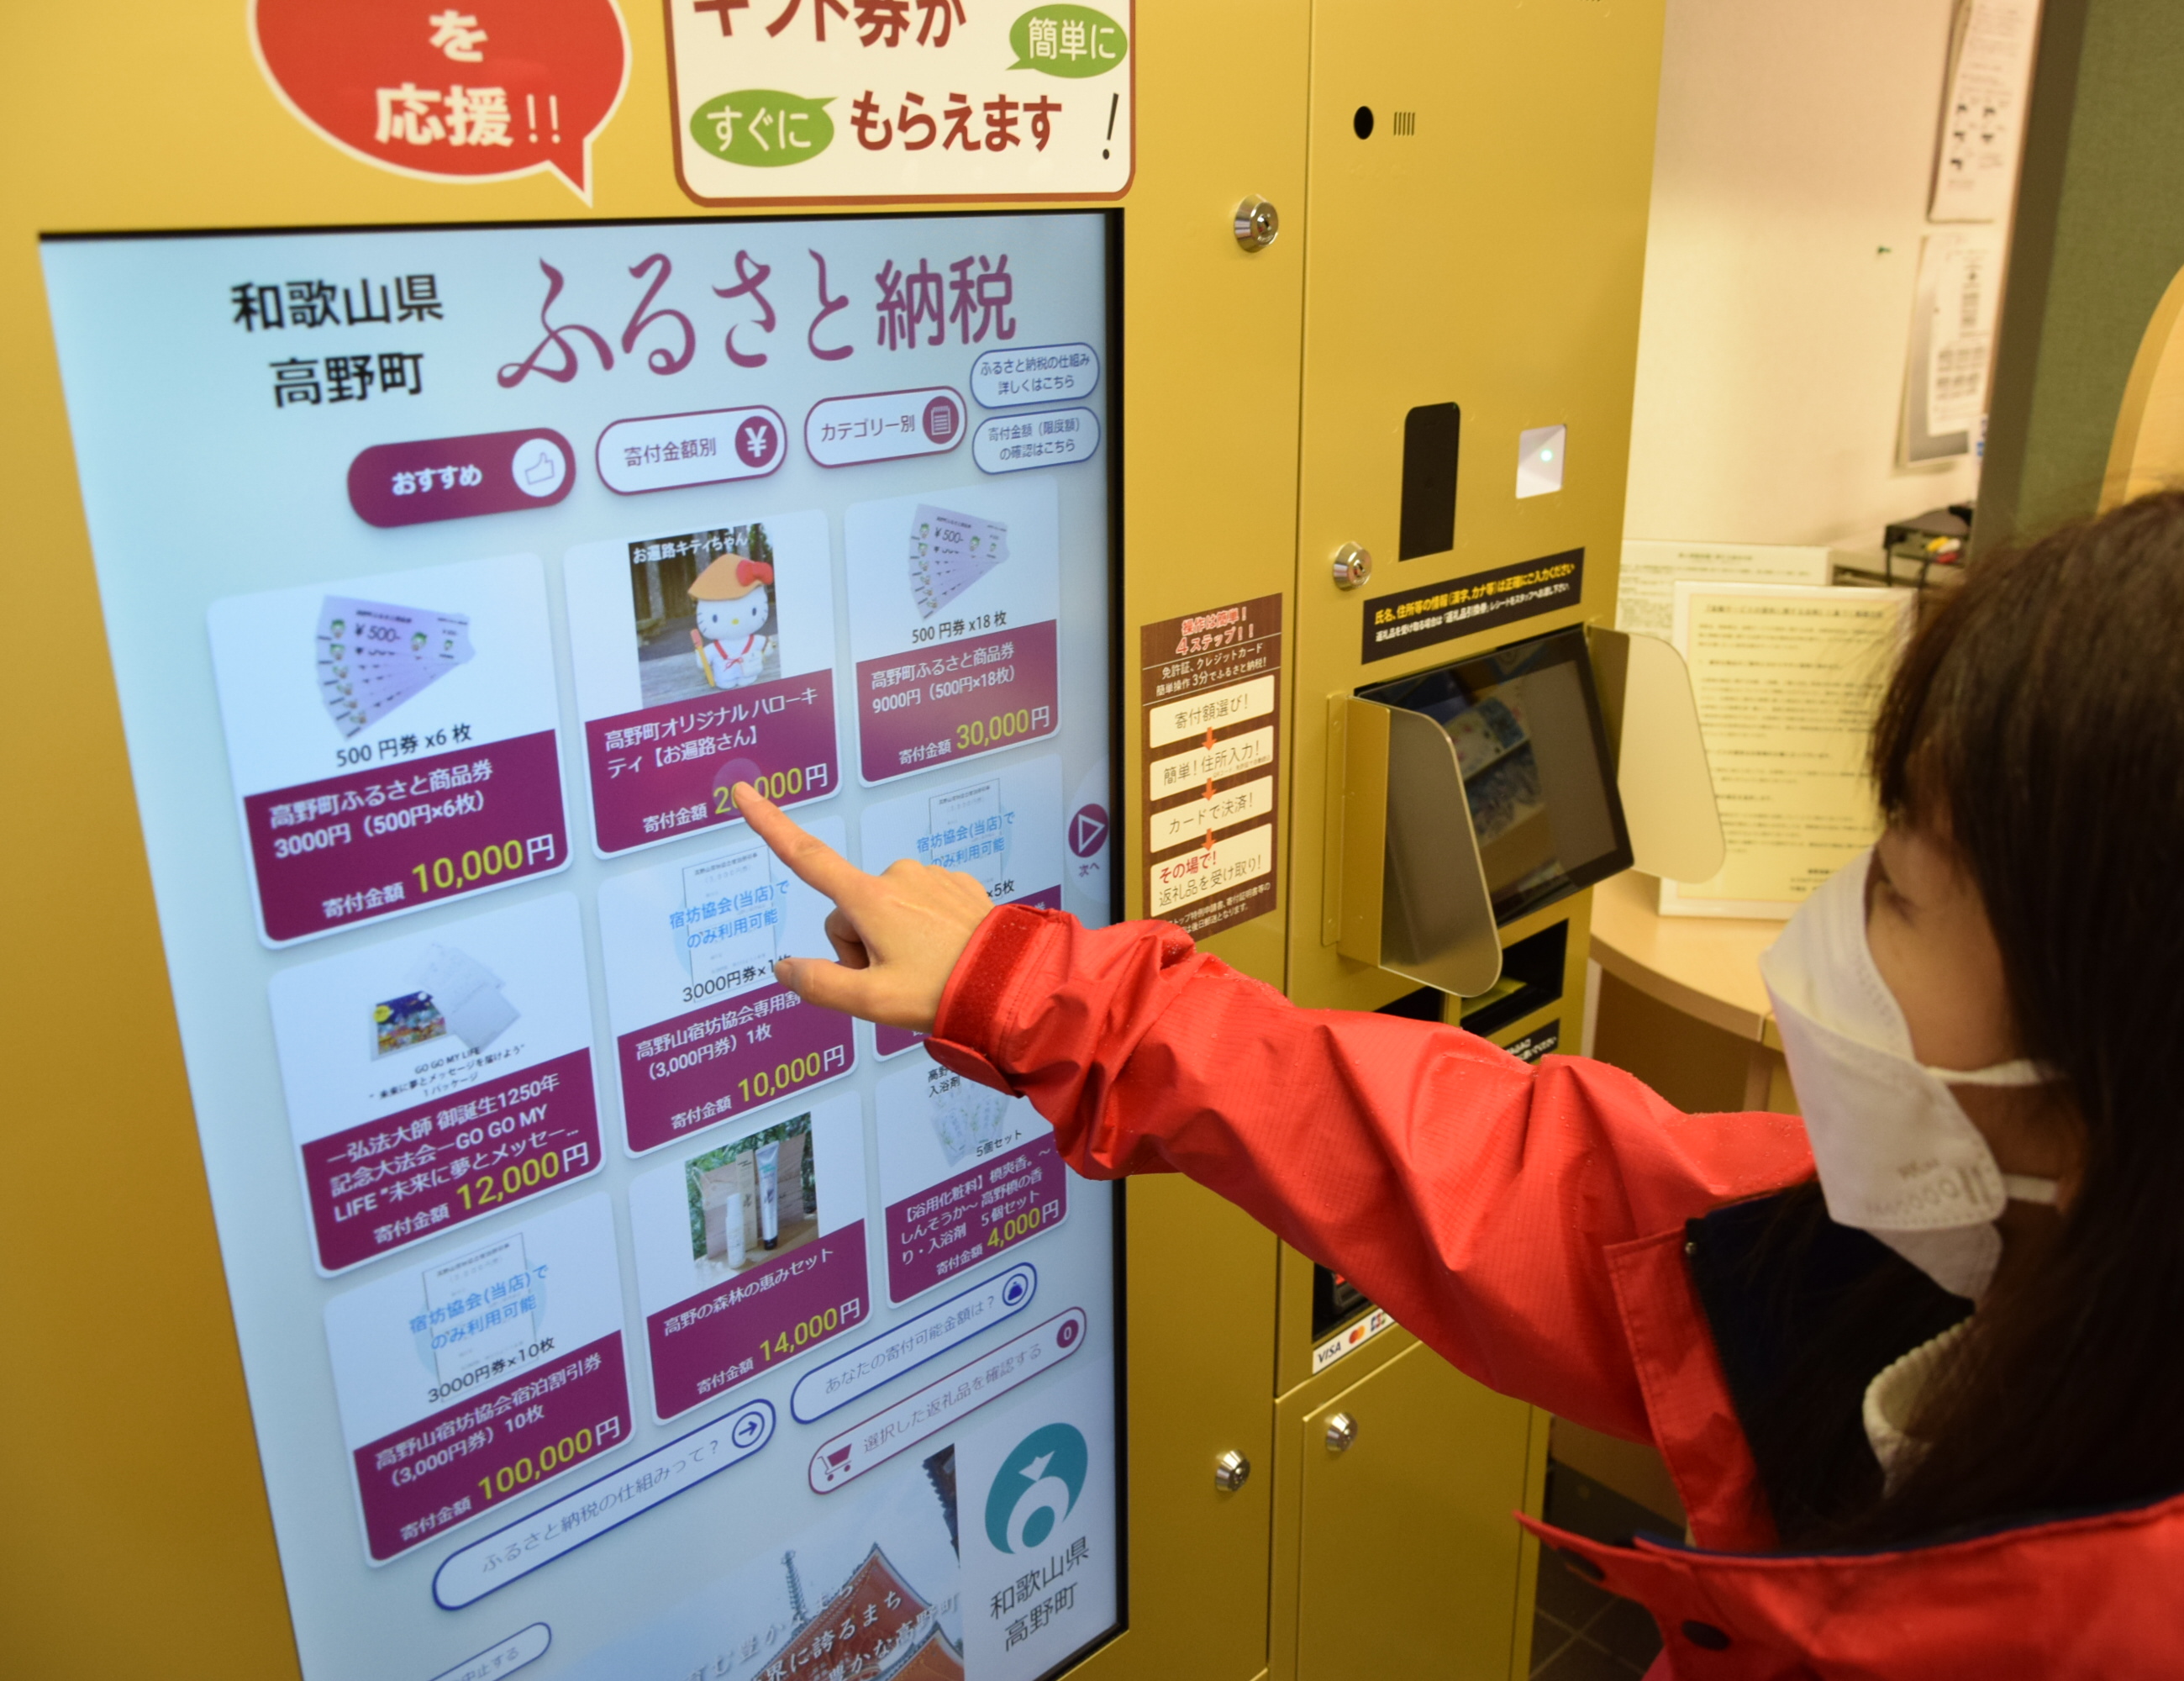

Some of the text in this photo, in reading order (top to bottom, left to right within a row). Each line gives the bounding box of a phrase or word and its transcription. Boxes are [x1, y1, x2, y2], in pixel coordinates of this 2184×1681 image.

[429, 10, 488, 62] を
[1029, 18, 1116, 61] 簡単に
[706, 105, 812, 152] すぐに
[230, 275, 445, 333] 和歌山県
[497, 247, 1016, 389] ふるさと納税
[269, 351, 424, 408] 高野町
[980, 353, 1090, 377] ふるさと納税の仕組み
[997, 375, 1075, 396] 詳しくはこちら
[821, 414, 915, 443] カテゴリー別
[624, 436, 717, 468] 寄付金額別
[999, 438, 1076, 461] の確認はこちら
[392, 465, 483, 497] おすすめ
[633, 532, 748, 564] お遍路キティちゃん
[871, 642, 1014, 691] 高野町ふるさと商品券
[899, 739, 951, 766] 寄付金額
[269, 759, 493, 830] 高野町ふるさと商品券
[643, 763, 829, 834] 寄付金額 2000円
[931, 837, 1005, 867] のみ利用可能
[1078, 862, 1099, 877] 次へ
[323, 882, 404, 919] 寄付金額
[687, 909, 778, 950] のみ利用可能
[436, 1073, 560, 1133] 御誕生1250年
[929, 1076, 960, 1098] 入浴剤
[488, 1116, 515, 1138] GO
[519, 1104, 548, 1127] MY
[671, 1095, 732, 1130] 寄付金額
[976, 1130, 1022, 1157] 5個セット
[334, 1192, 377, 1222] LIFE
[374, 1204, 450, 1244] 寄付金額
[937, 1244, 982, 1275] 寄付金額
[664, 1248, 834, 1336] 高野の森林の恵みセット
[431, 1294, 537, 1351] のみ利用可能
[825, 1295, 994, 1394] あなたの寄付可能金額は？
[1318, 1341, 1341, 1363] VISA
[697, 1357, 754, 1394] 寄付金額
[375, 1352, 602, 1471] 高野山宿坊協会宿泊割引券
[863, 1343, 1042, 1454] 選択した返礼品を確認する
[400, 1496, 472, 1541] 寄付金額
[483, 1439, 719, 1573] ふるさと納税の仕組みって？
[990, 1536, 1089, 1621] 和歌山県
[1004, 1583, 1078, 1652] 高野町
